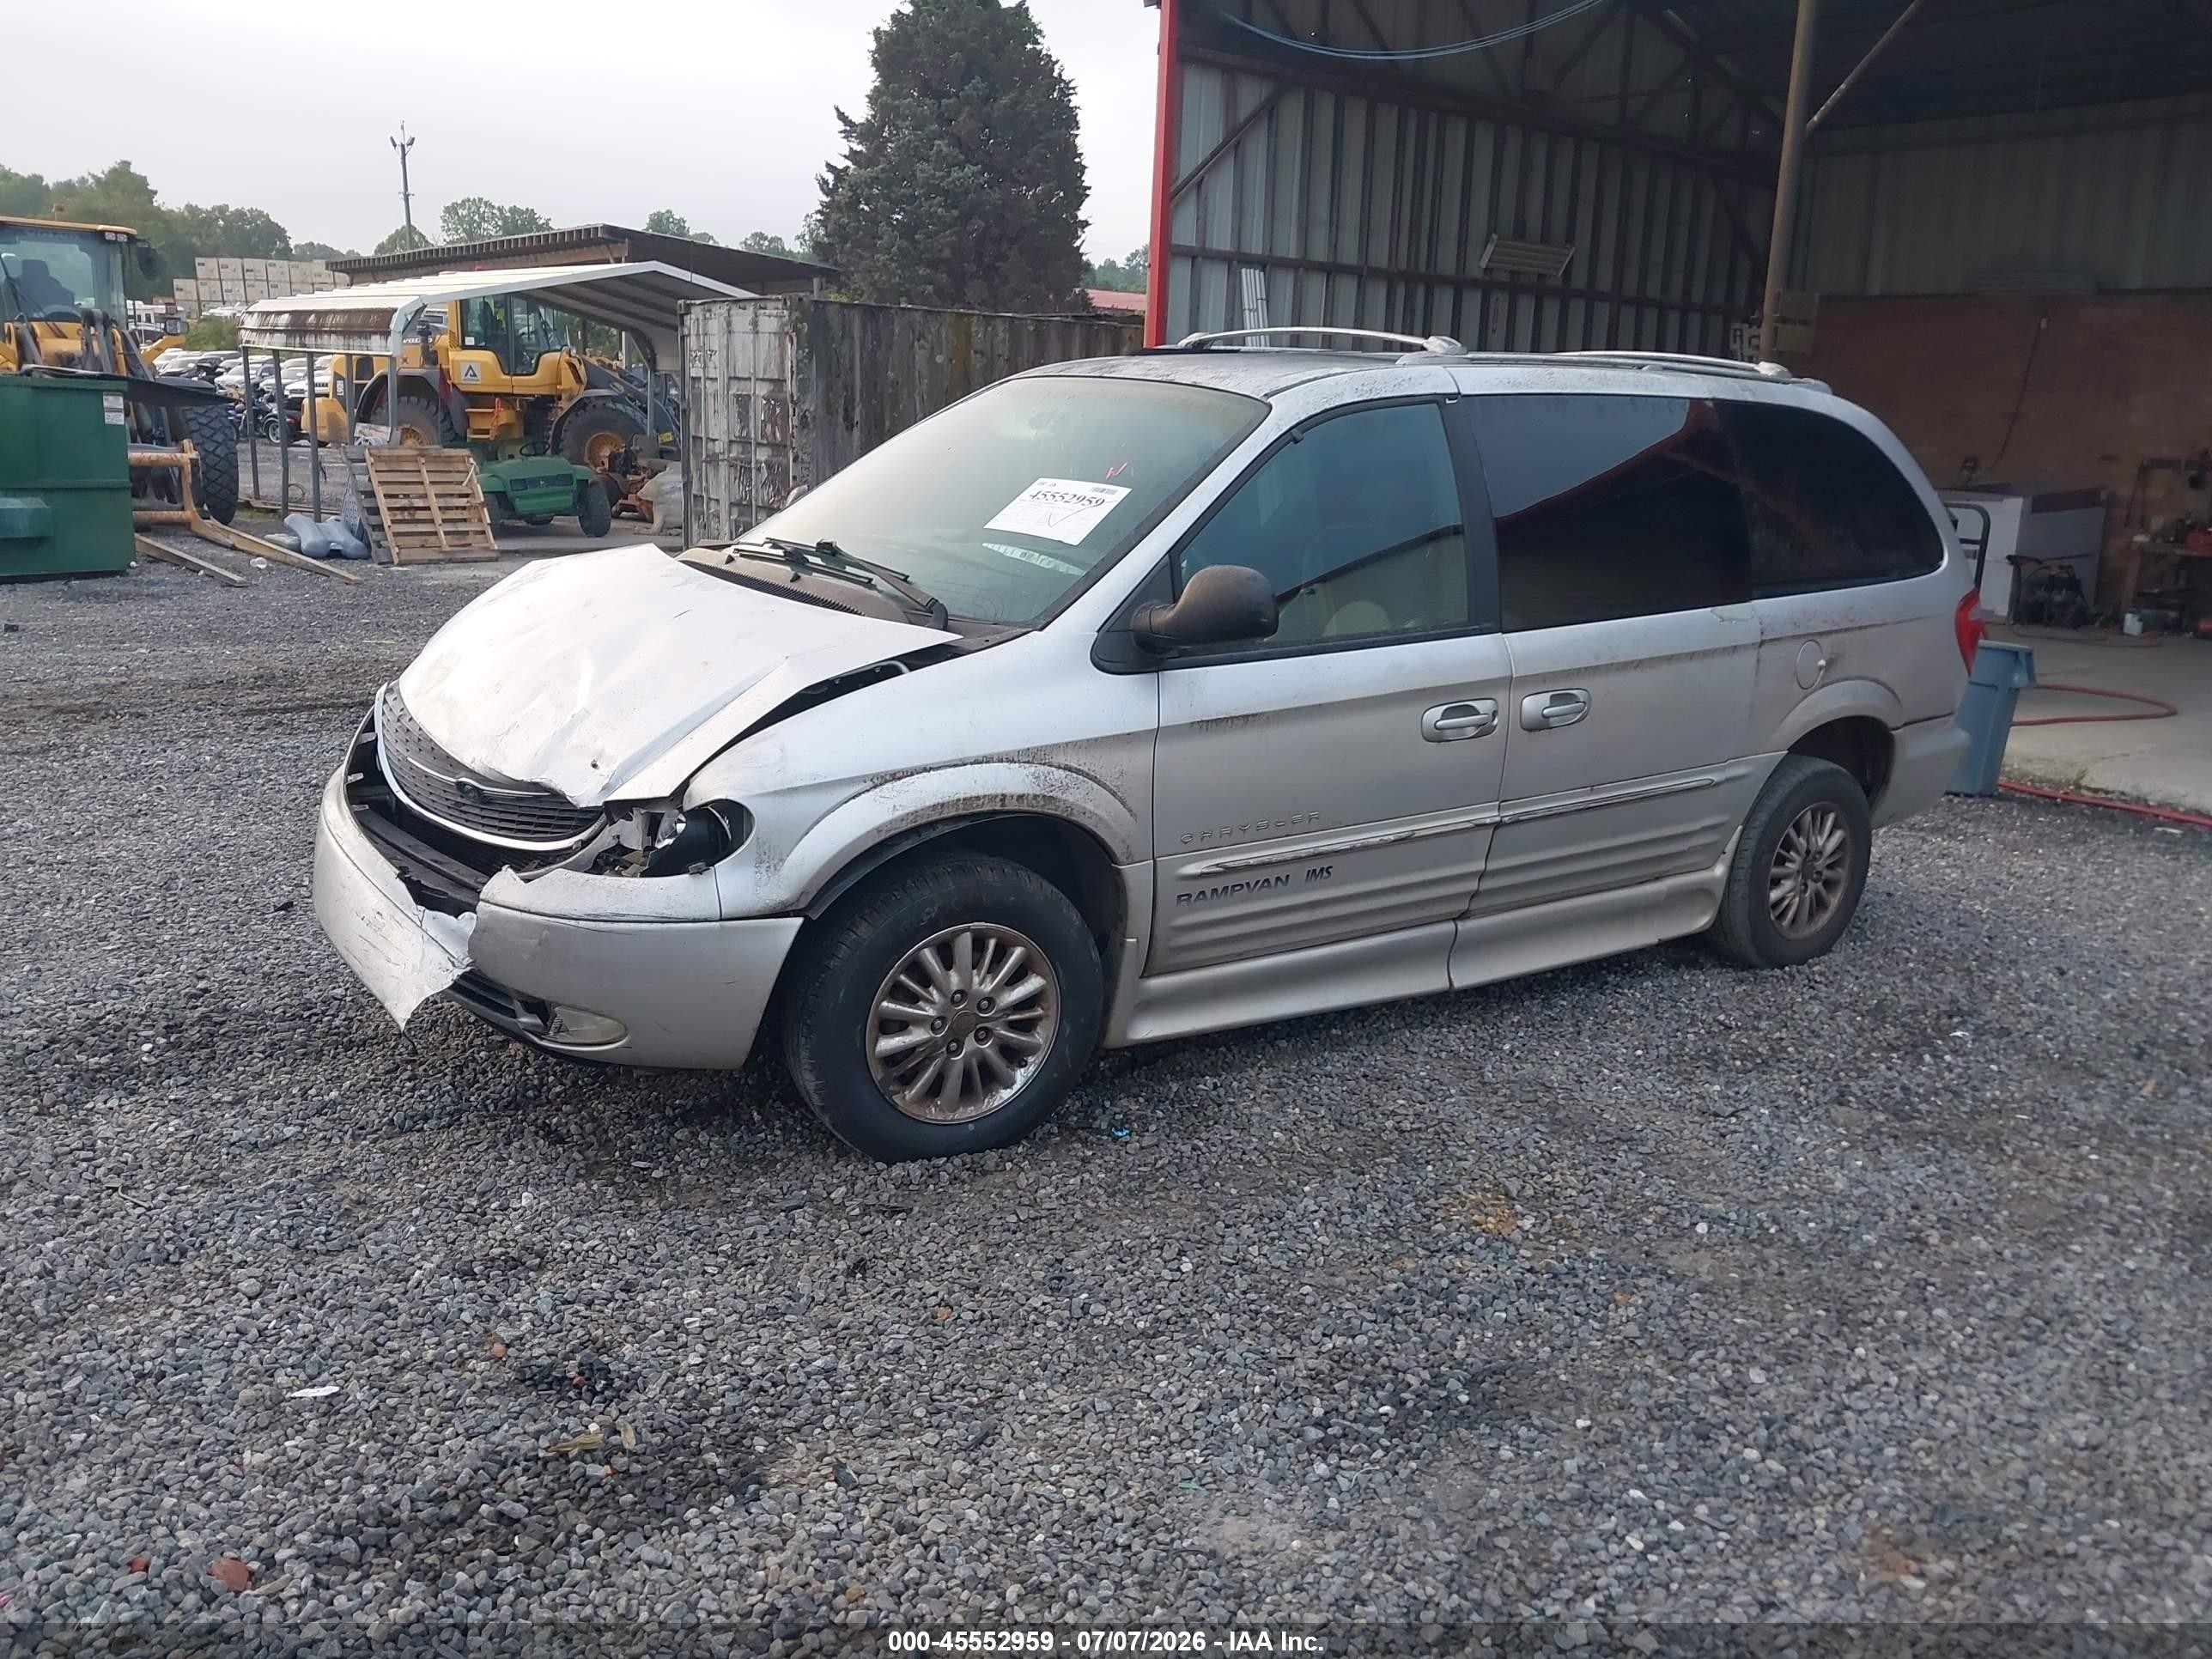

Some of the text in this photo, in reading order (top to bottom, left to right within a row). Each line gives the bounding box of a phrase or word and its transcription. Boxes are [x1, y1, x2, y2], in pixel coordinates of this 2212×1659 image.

[1030, 489, 1105, 507] 45552959
[1180, 811, 1320, 843] CHRYSLER
[1176, 866, 1334, 907] RAMPVAN IMS
